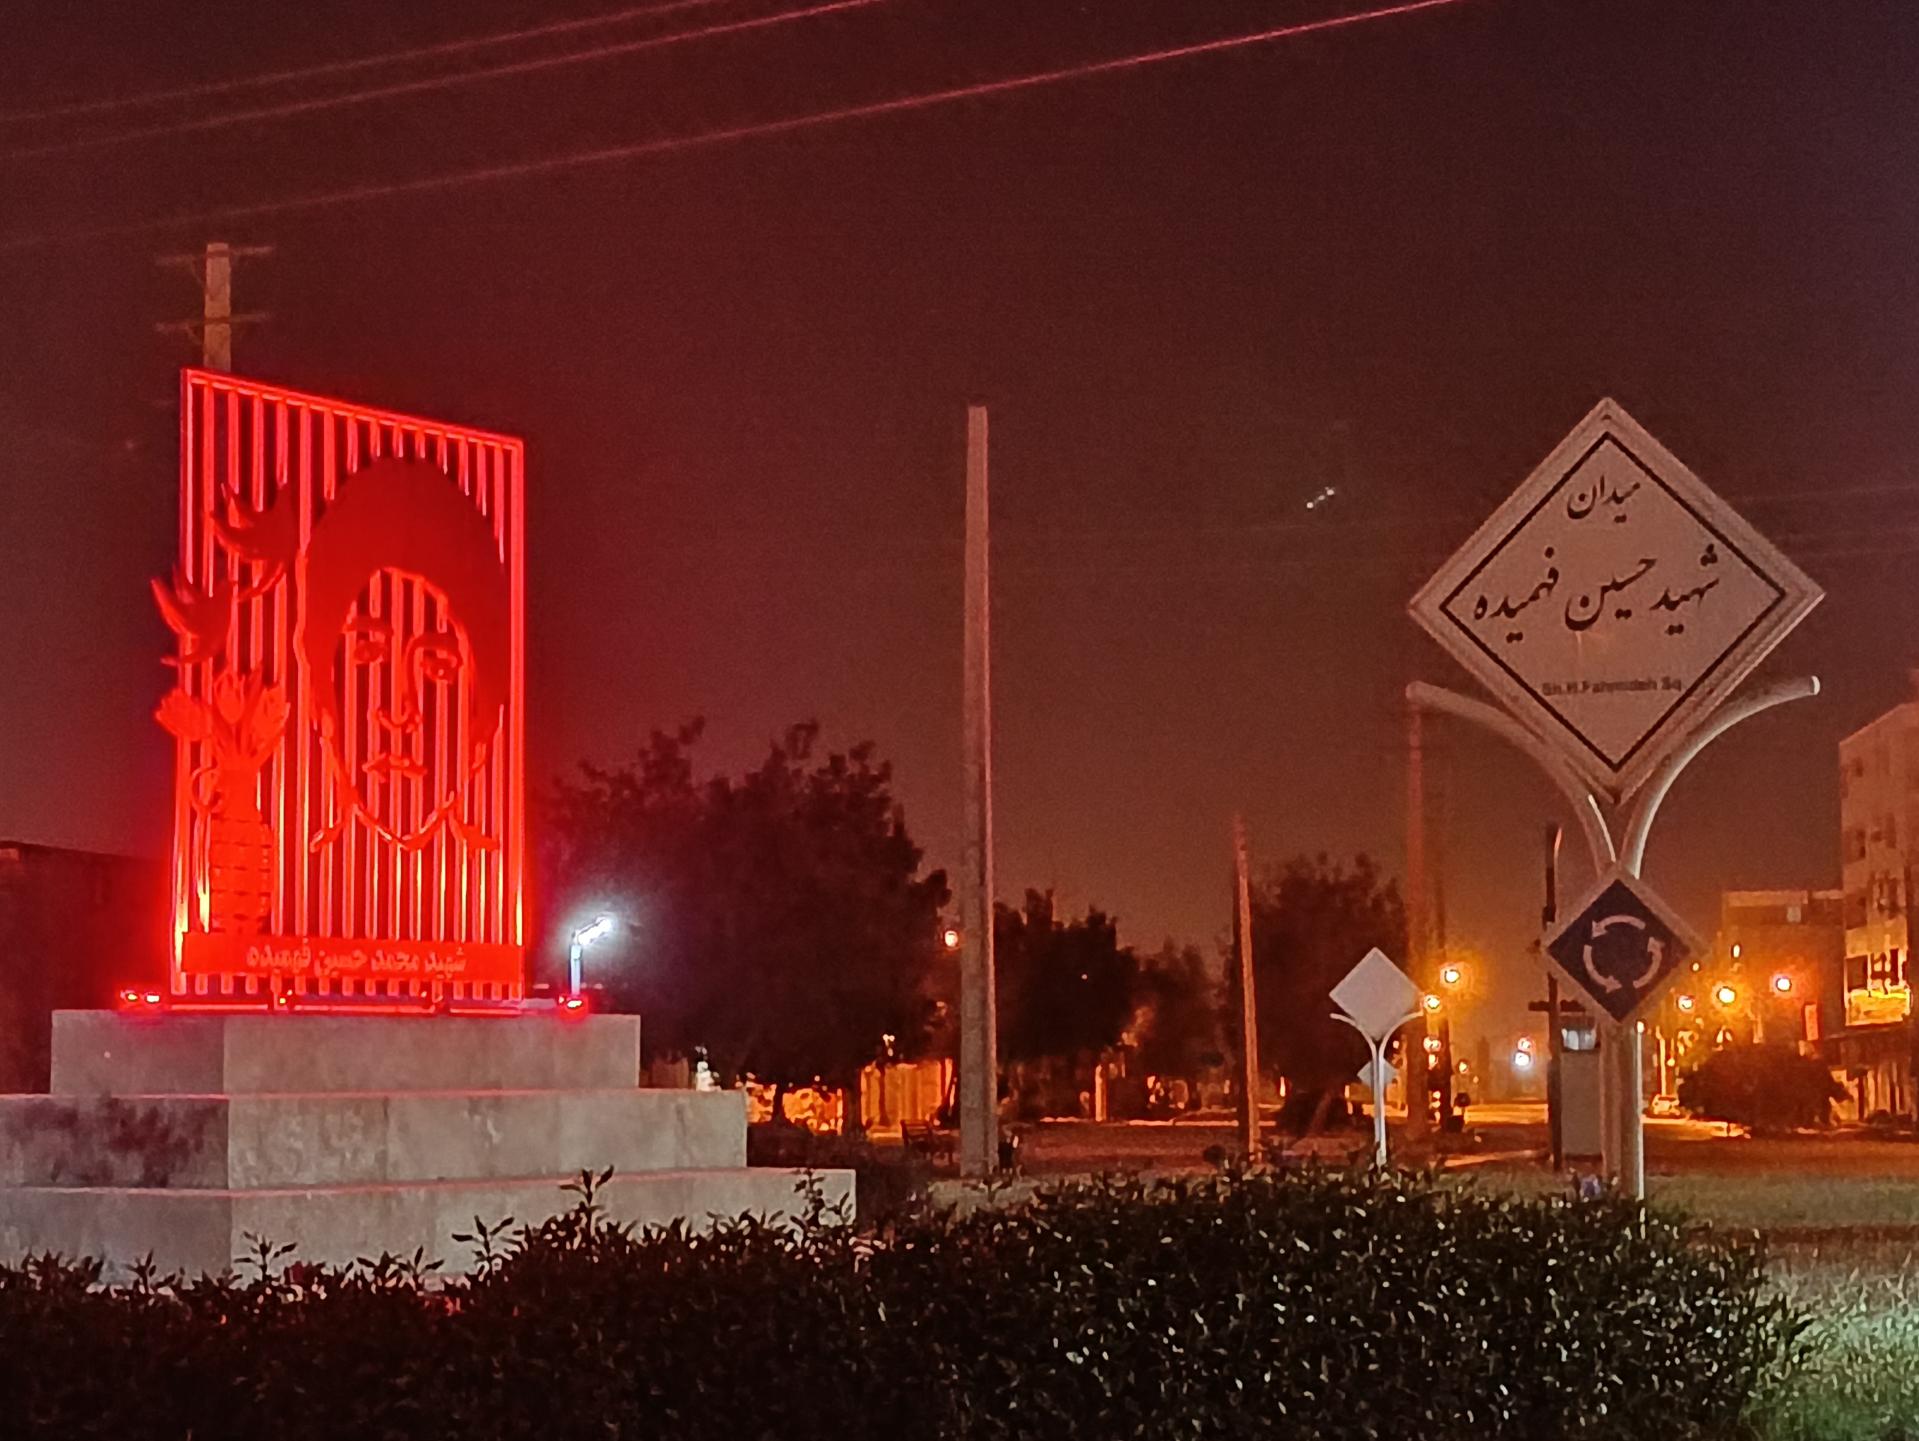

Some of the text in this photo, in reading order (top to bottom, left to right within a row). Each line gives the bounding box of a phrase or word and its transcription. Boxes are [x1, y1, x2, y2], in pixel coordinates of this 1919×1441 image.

[1567, 475, 1640, 522] میدان
[1474, 543, 1720, 642] شهید حسین فهمیده
[246, 938, 467, 980] شهید محمد حسین فهمیده
